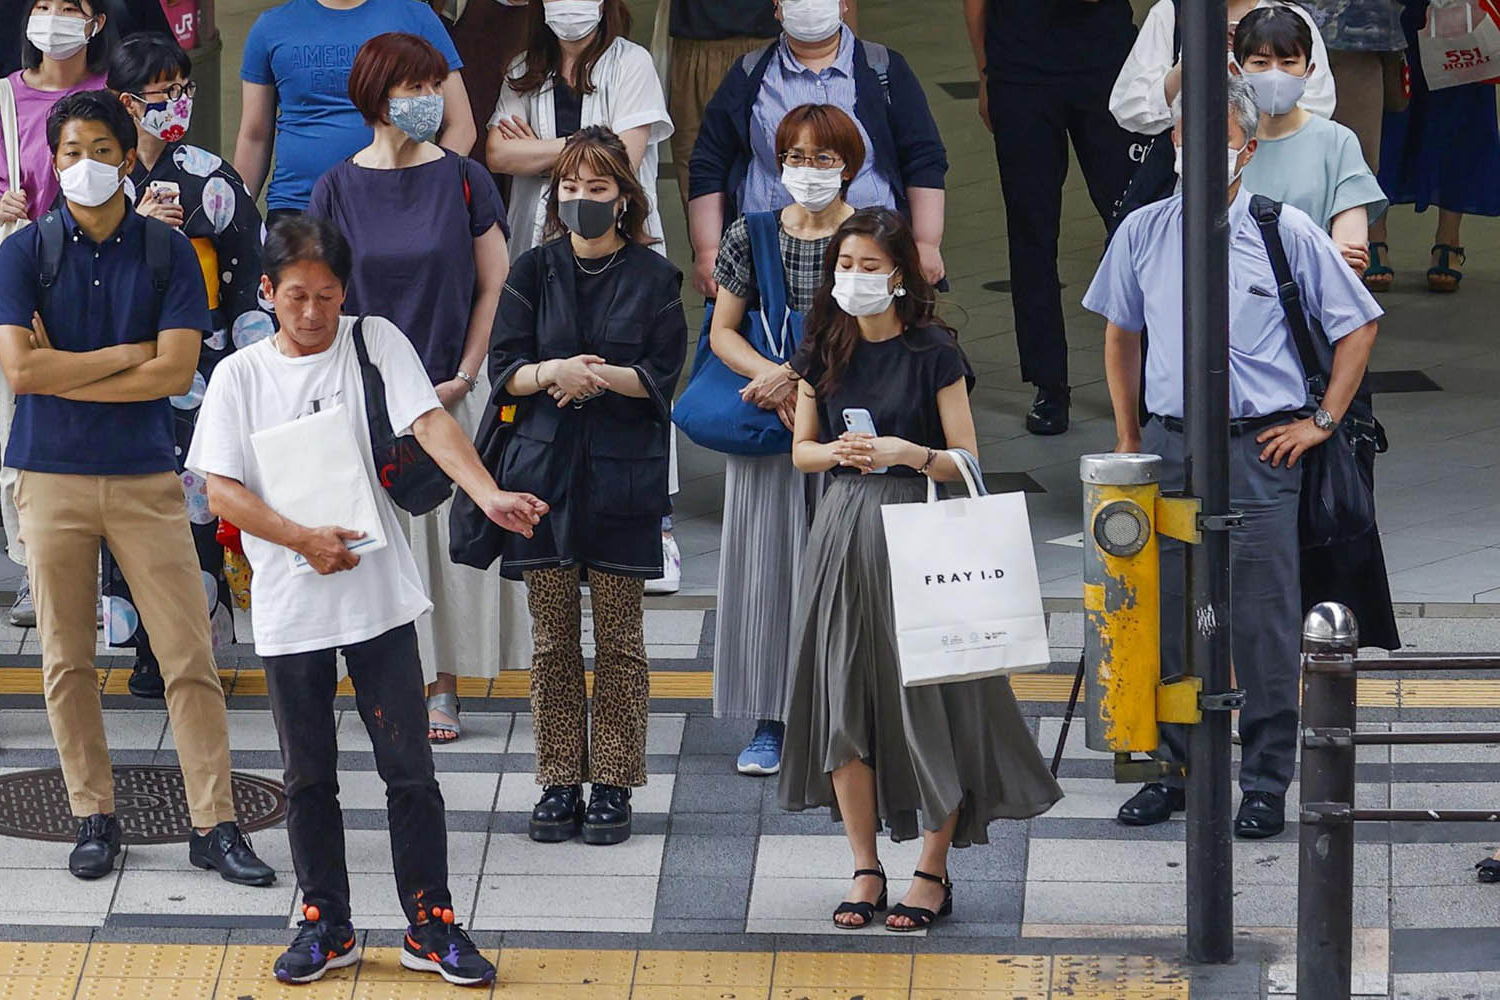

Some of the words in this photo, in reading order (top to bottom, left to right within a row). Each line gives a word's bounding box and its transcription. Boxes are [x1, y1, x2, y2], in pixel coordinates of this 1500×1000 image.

[175, 12, 194, 35] JR
[924, 571, 973, 586] FRAY
[981, 568, 1005, 580] I.D
